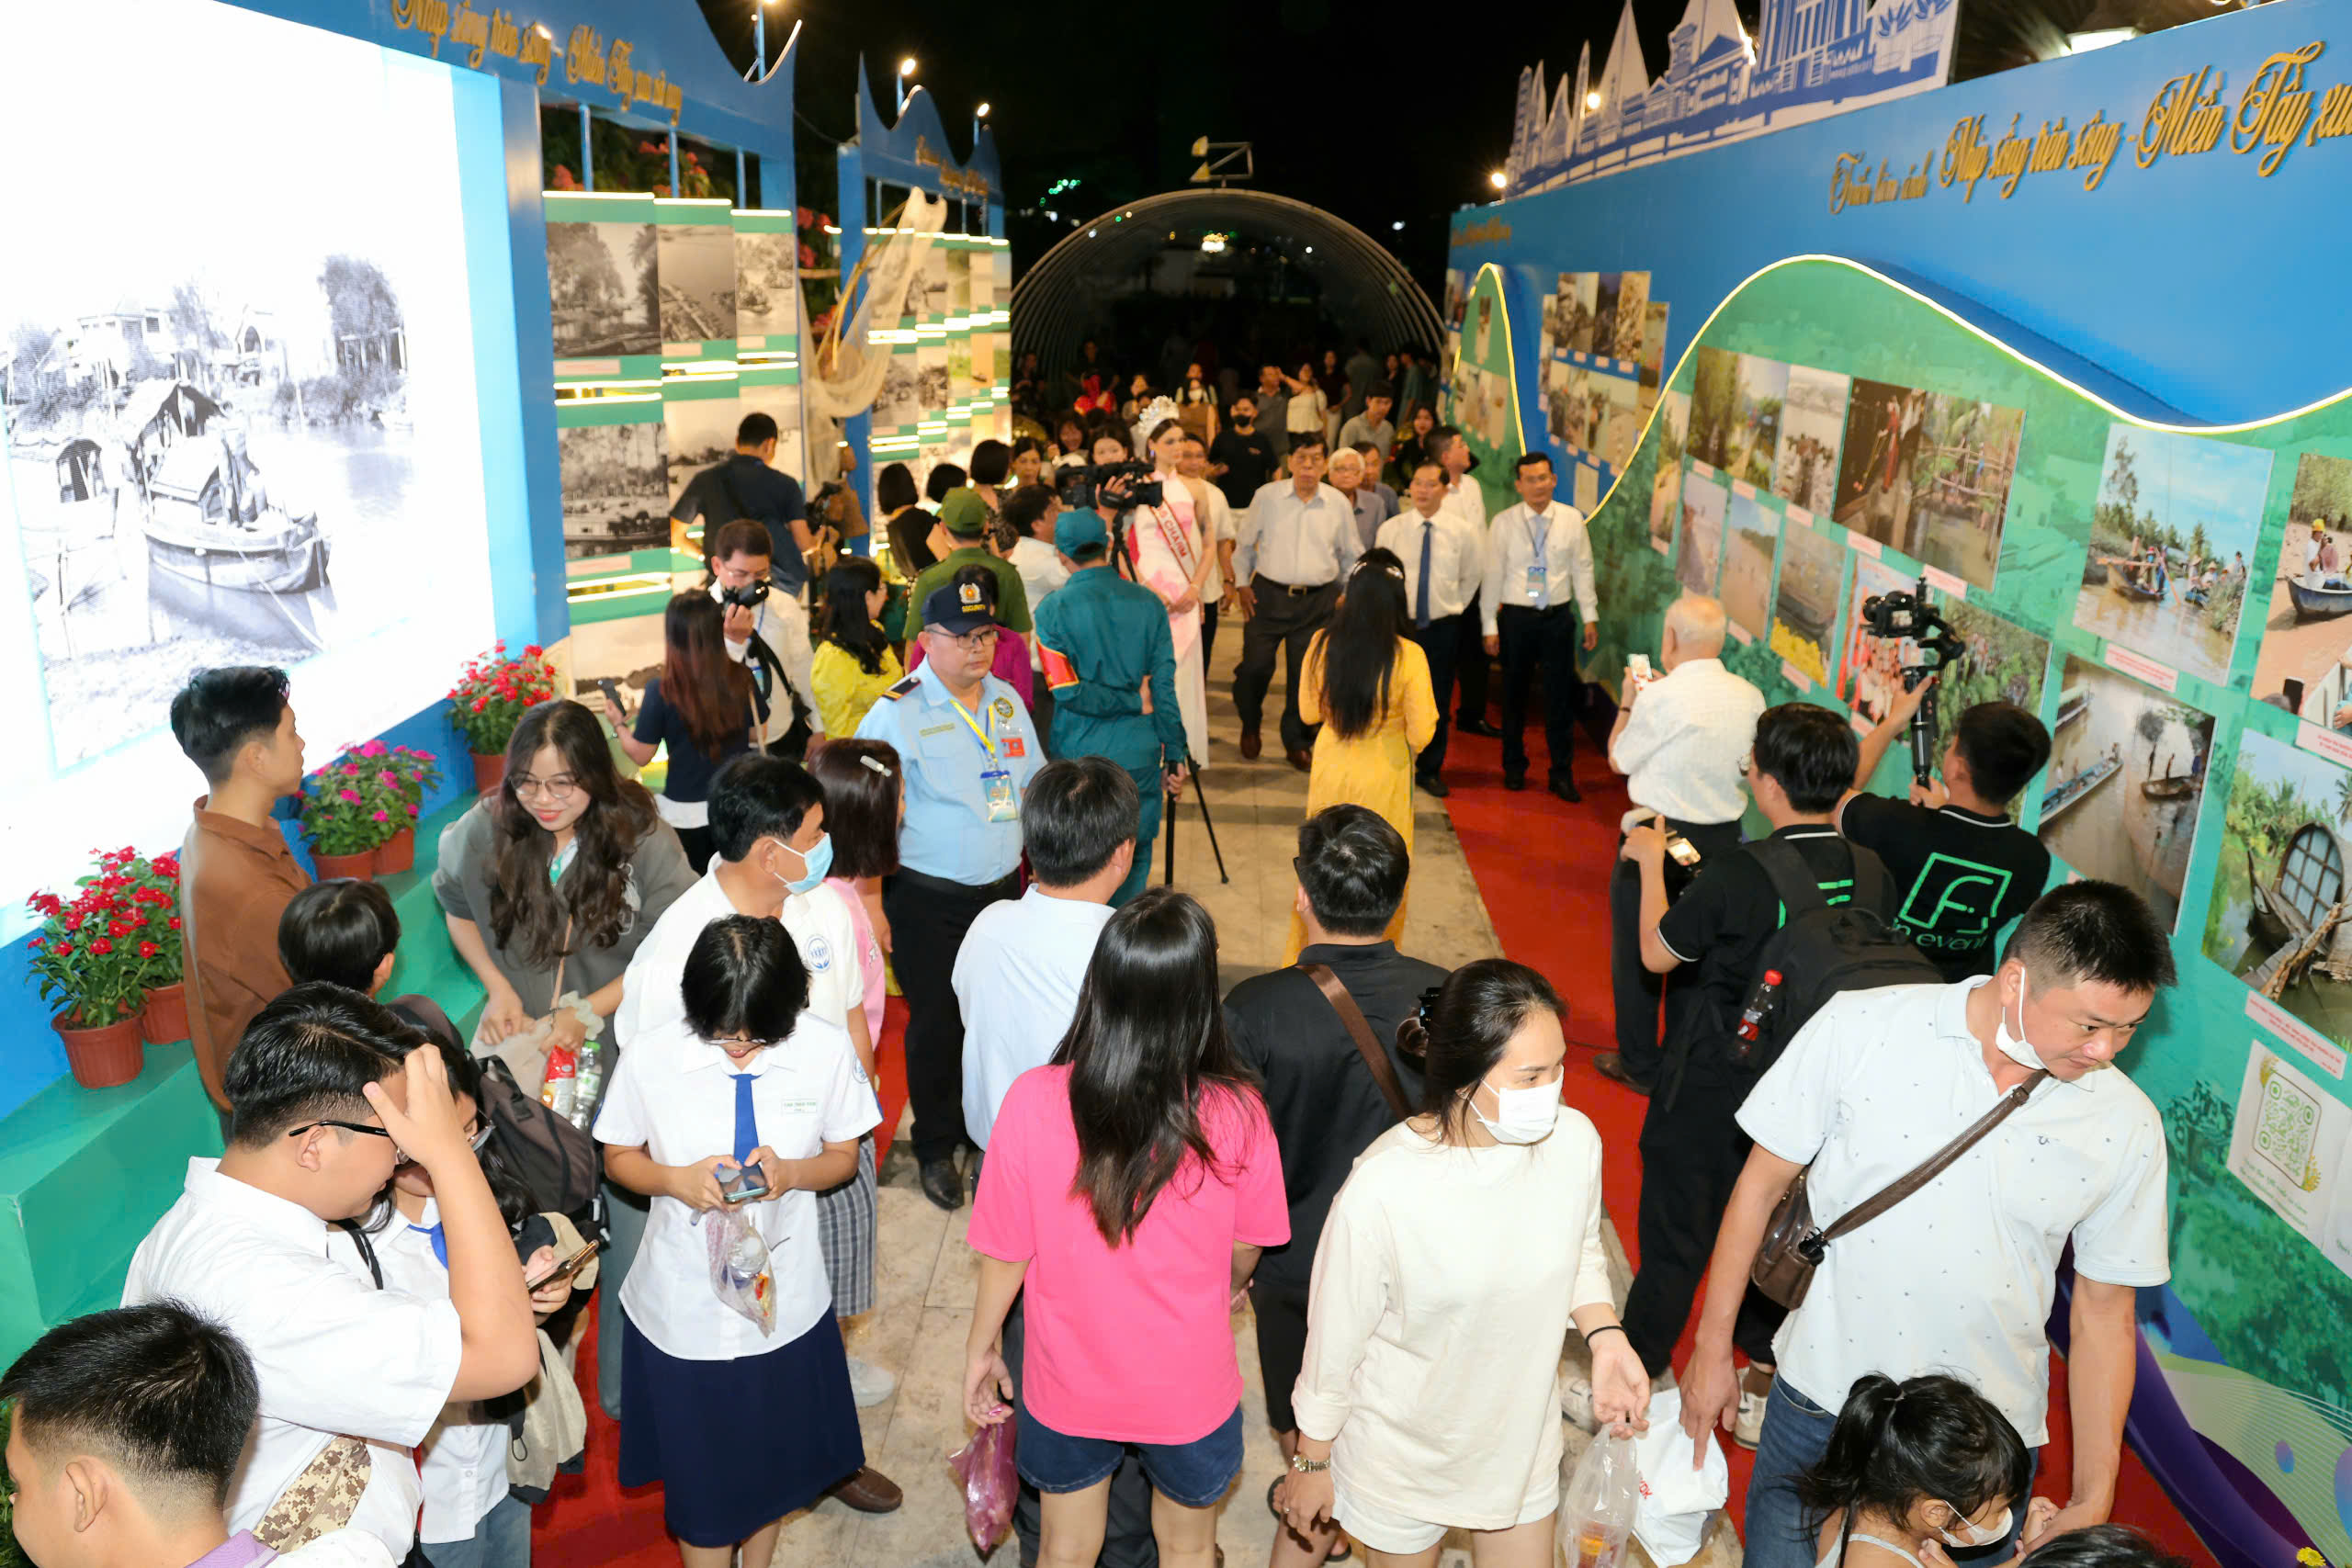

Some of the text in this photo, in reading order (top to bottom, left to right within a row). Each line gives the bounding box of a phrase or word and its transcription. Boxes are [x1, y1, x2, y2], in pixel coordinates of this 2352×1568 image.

[1939, 113, 1991, 204] Nhịp
[1986, 112, 2033, 199] sống
[2067, 109, 2125, 192] sông
[2135, 64, 2228, 169] Miền
[2230, 40, 2326, 177] Tây
